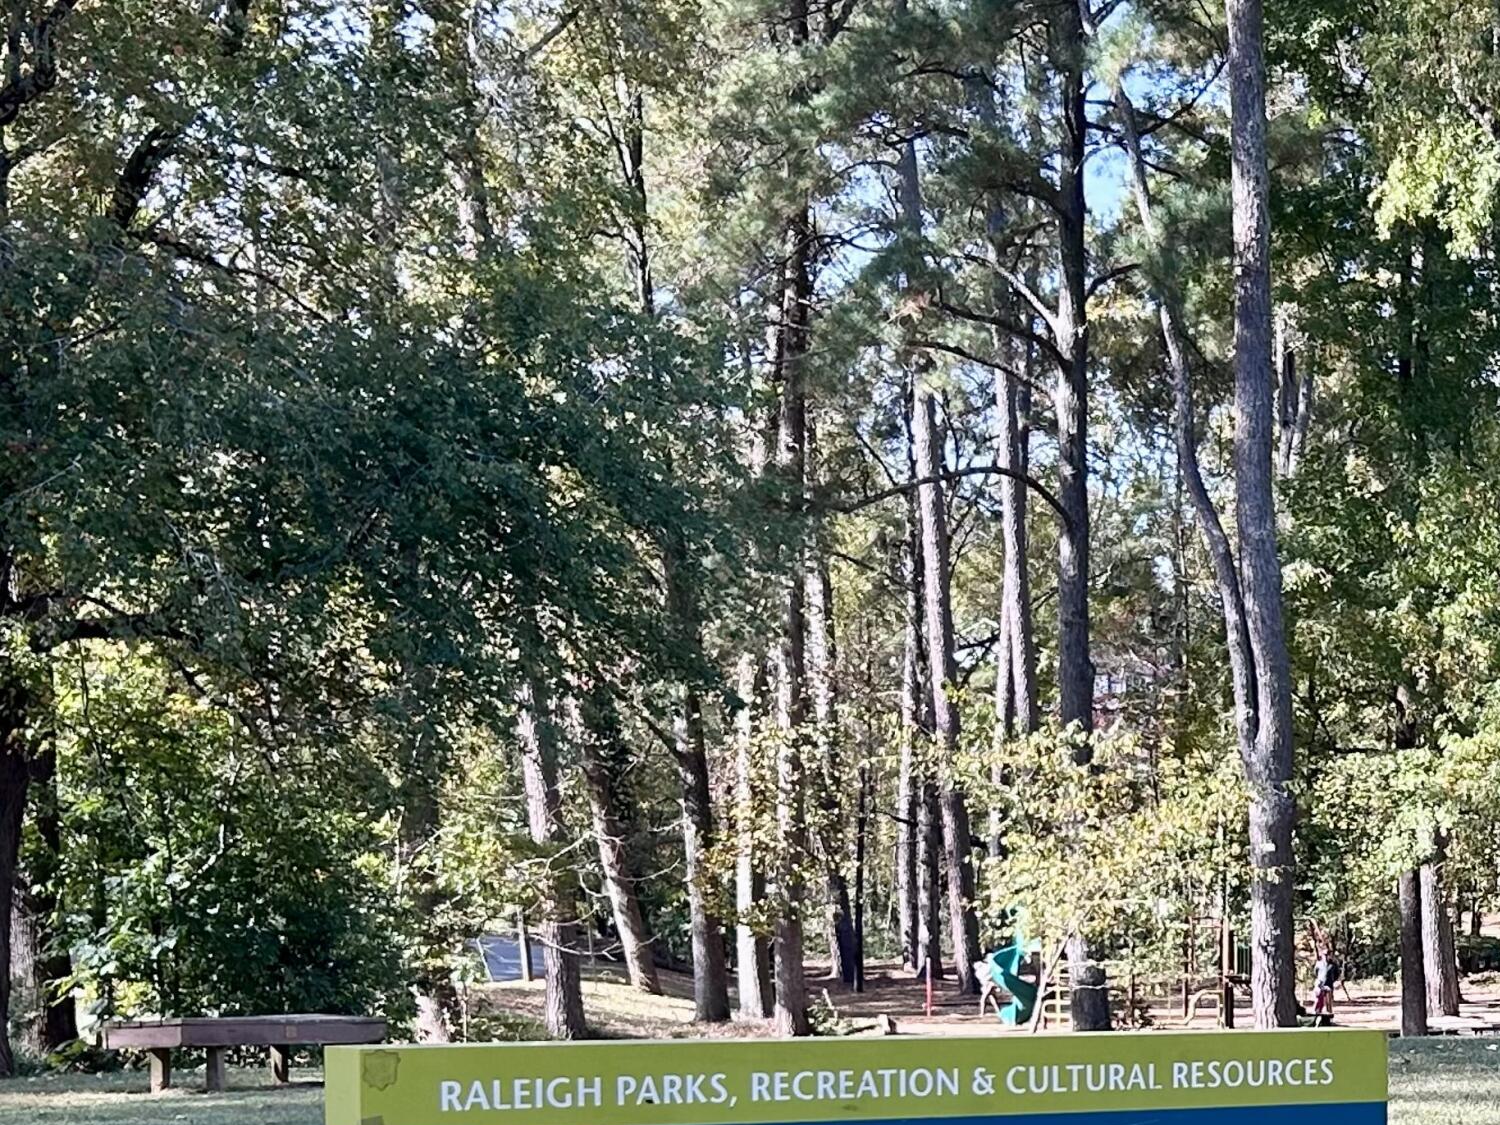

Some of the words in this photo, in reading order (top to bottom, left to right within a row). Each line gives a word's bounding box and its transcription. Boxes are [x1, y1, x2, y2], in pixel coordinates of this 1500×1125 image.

[440, 1076, 602, 1112] RALEIGH
[617, 1073, 737, 1108] PARKS,
[751, 1067, 960, 1102] RECREATION
[971, 1067, 997, 1096] &
[1006, 1063, 1163, 1094] CULTURAL
[1172, 1058, 1335, 1089] RESOURCES
